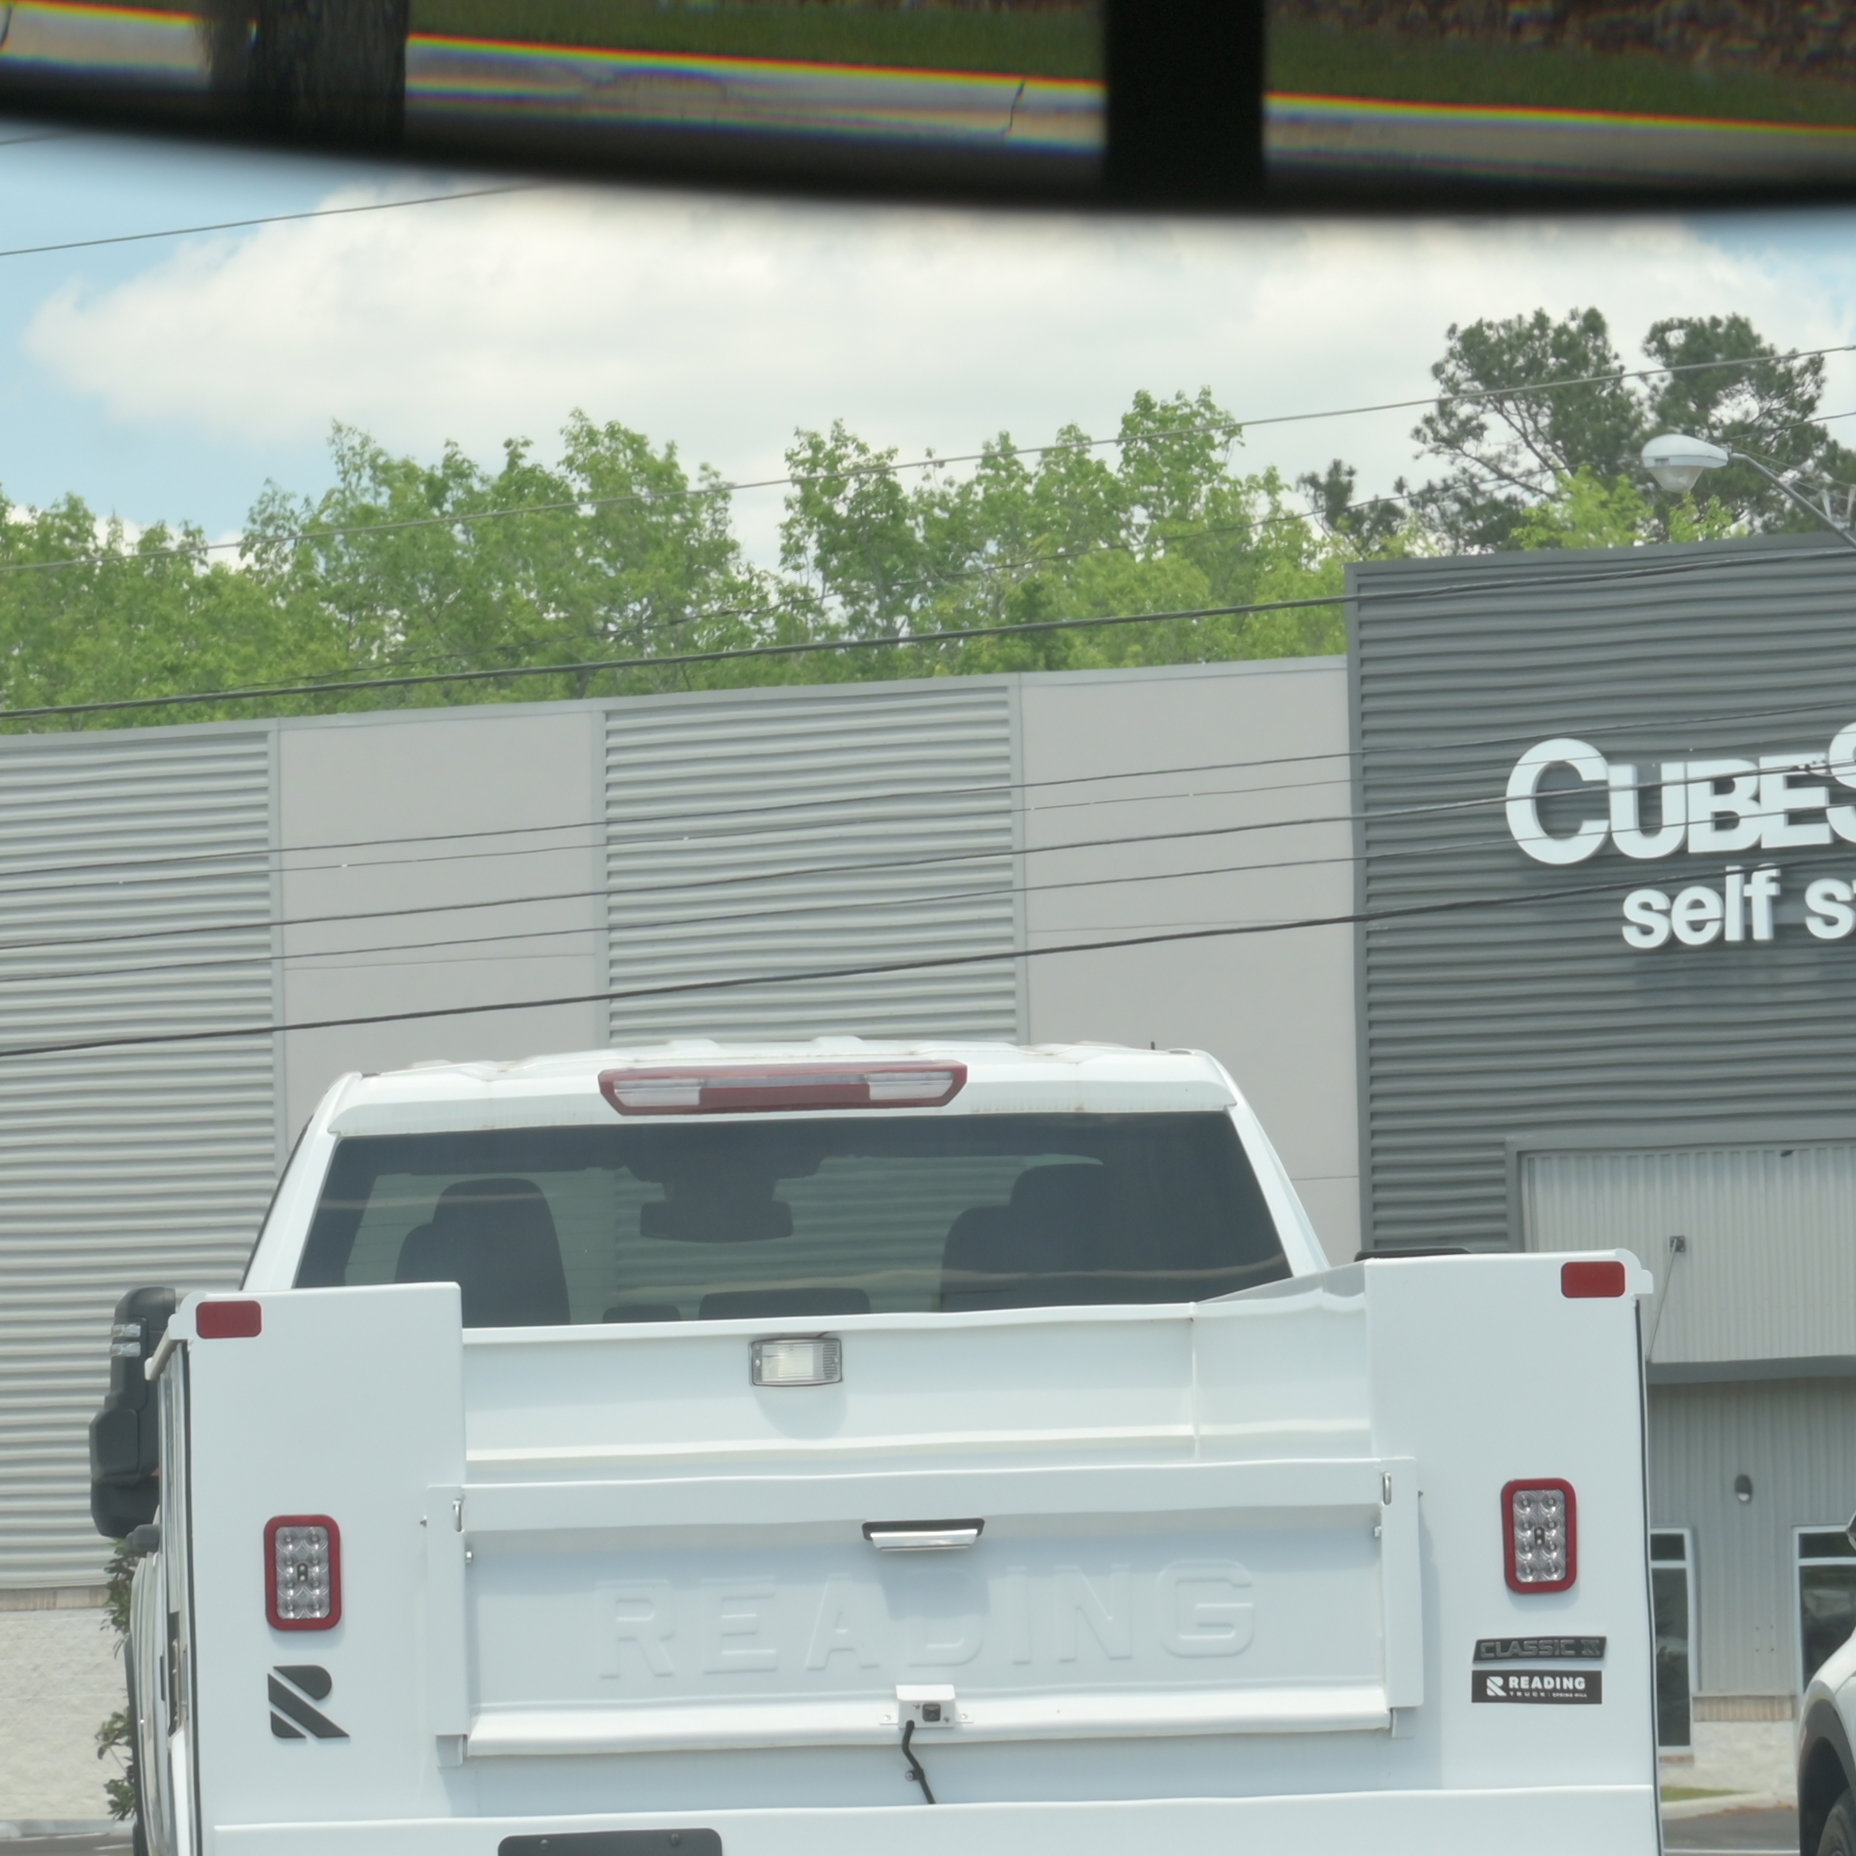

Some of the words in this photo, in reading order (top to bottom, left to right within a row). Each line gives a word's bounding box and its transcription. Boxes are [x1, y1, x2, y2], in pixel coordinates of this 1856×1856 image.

[1622, 863, 1781, 949] self
[596, 1560, 1256, 1680] READING
[1480, 1639, 1576, 1659] CLASSIC
[1508, 1676, 1586, 1691] READING
